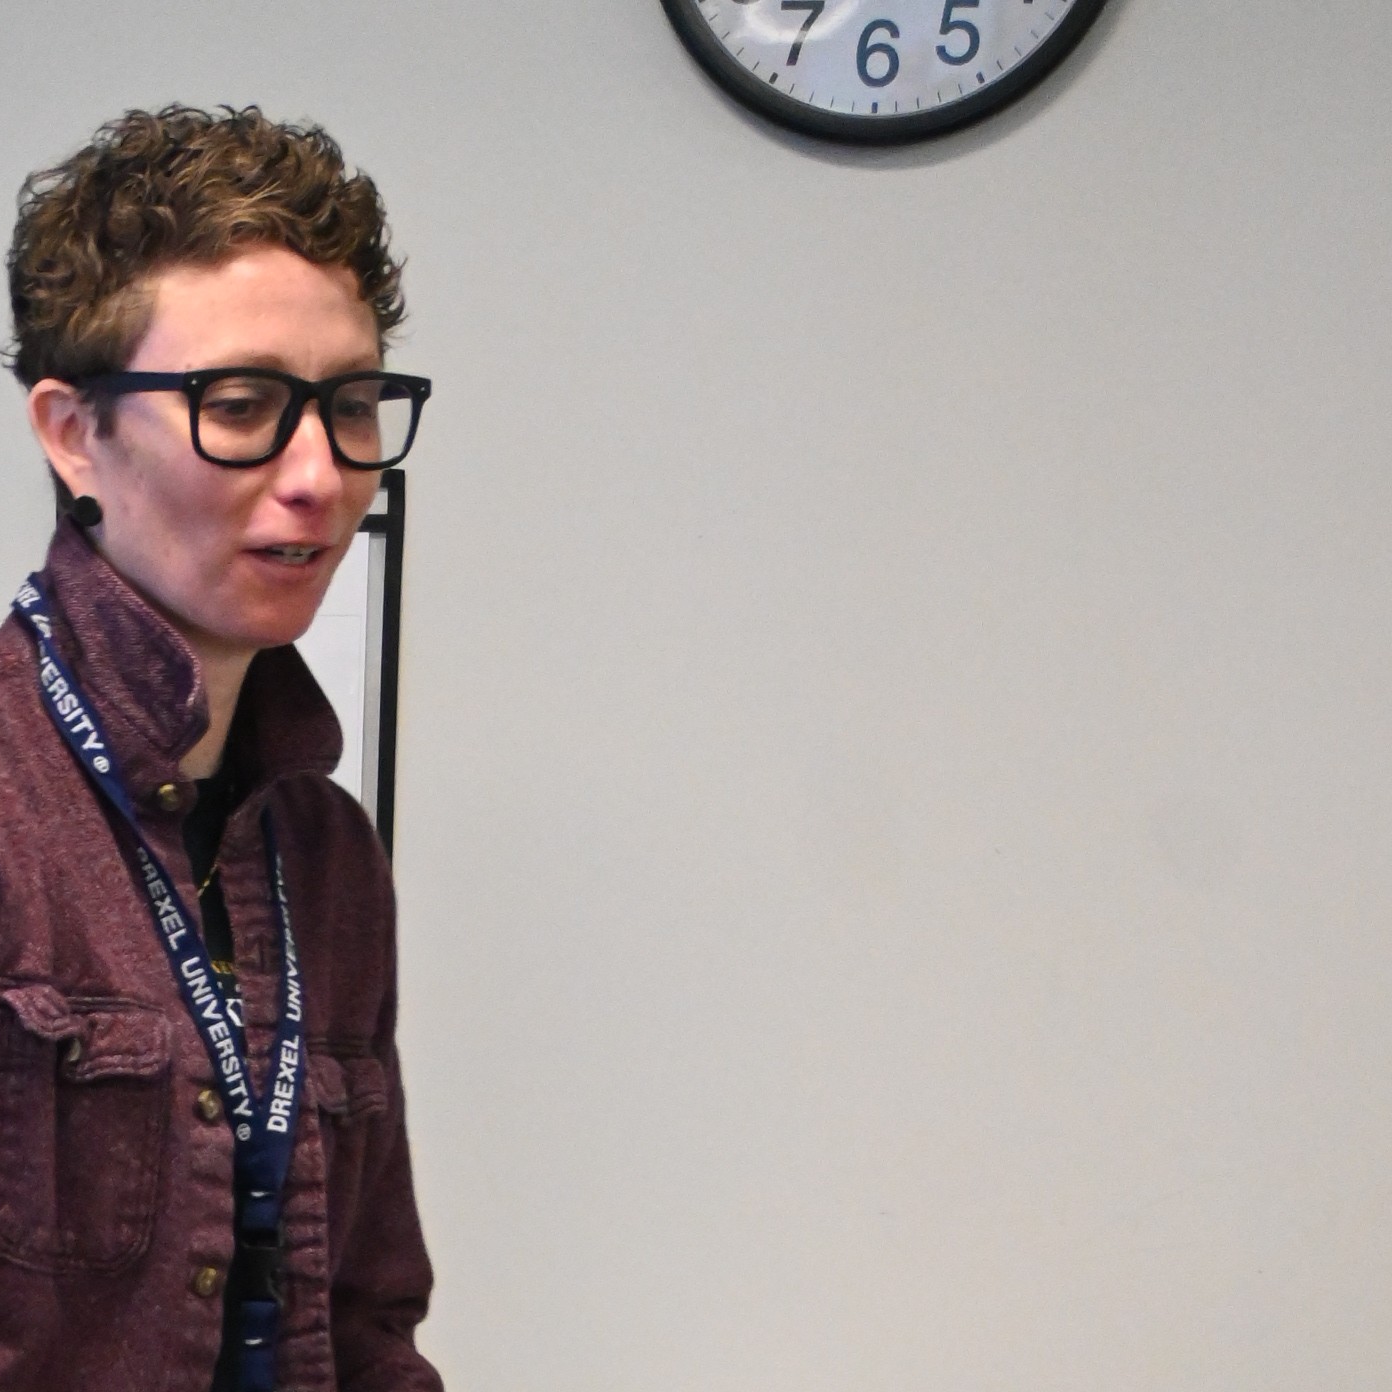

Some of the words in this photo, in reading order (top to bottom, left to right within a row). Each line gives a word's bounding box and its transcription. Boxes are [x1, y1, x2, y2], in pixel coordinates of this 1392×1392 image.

[781, 0, 823, 66] 7
[856, 19, 900, 87] 6
[936, 0, 980, 66] 5
[266, 1035, 300, 1133] DREXEL
